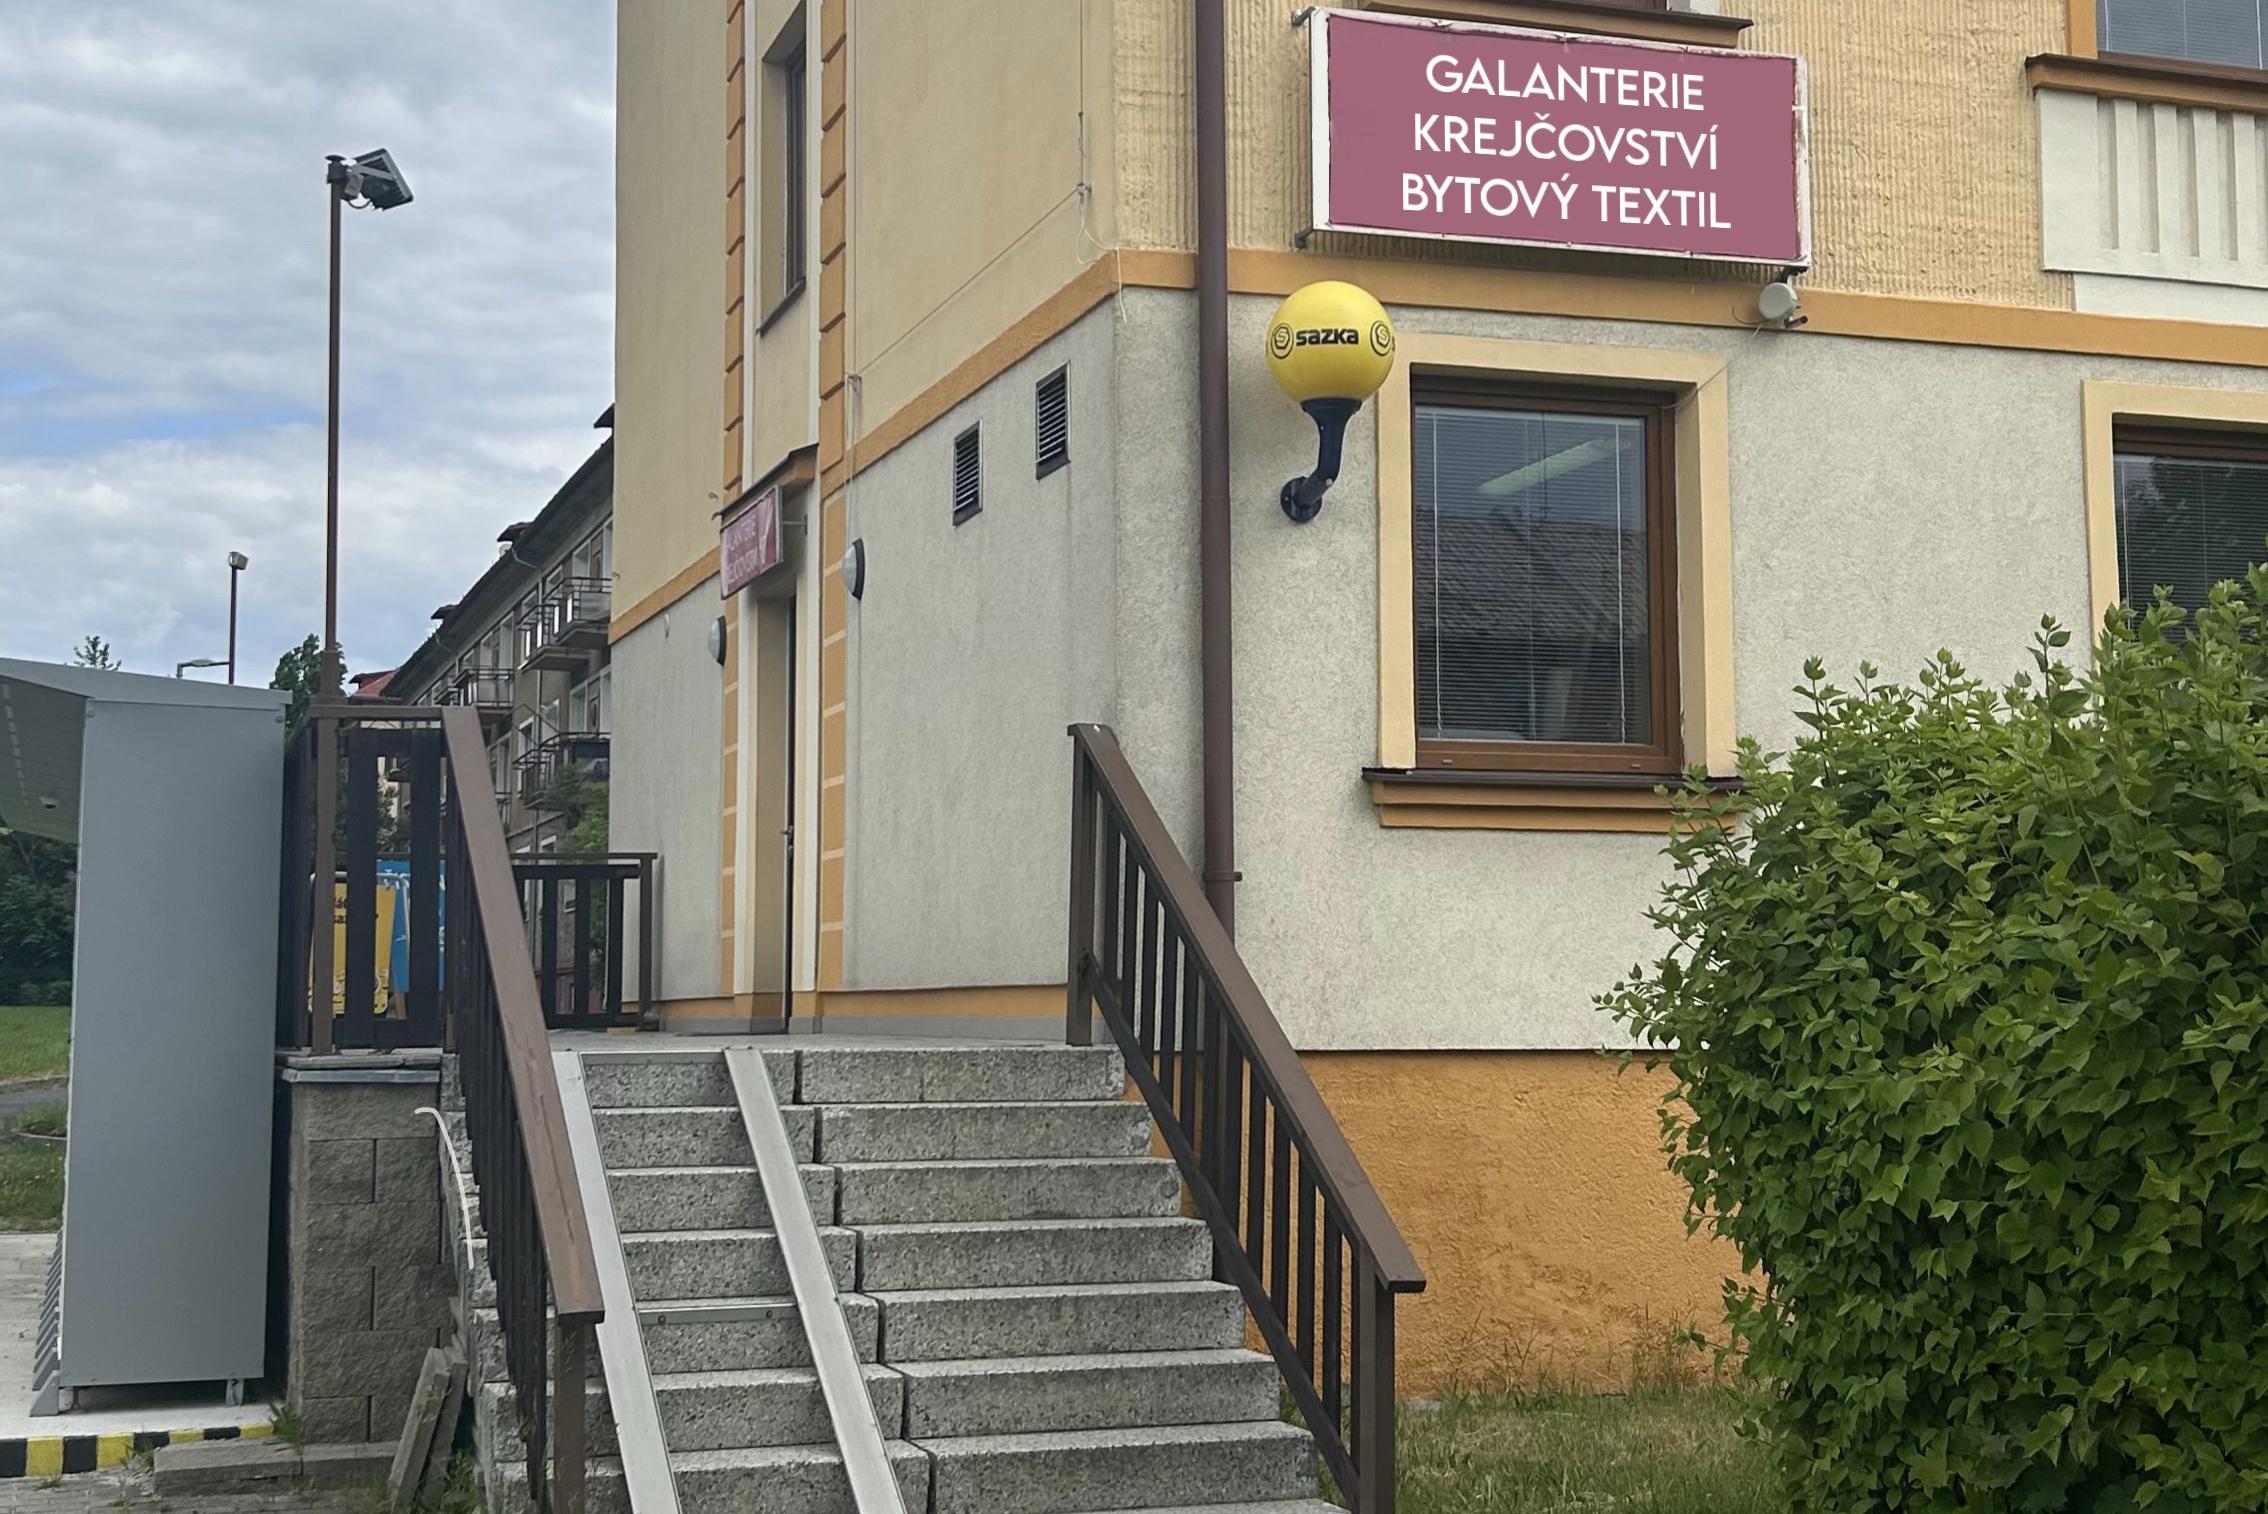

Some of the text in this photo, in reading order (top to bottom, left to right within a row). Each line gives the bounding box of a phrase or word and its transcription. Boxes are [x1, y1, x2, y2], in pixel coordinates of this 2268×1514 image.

[1425, 54, 1705, 111] GALANTERIE
[1414, 112, 1719, 171] KREJČOVSTVÍ
[1402, 173, 1732, 229] BYTOVÝ TEXTIL
[1296, 328, 1359, 346] sazka
